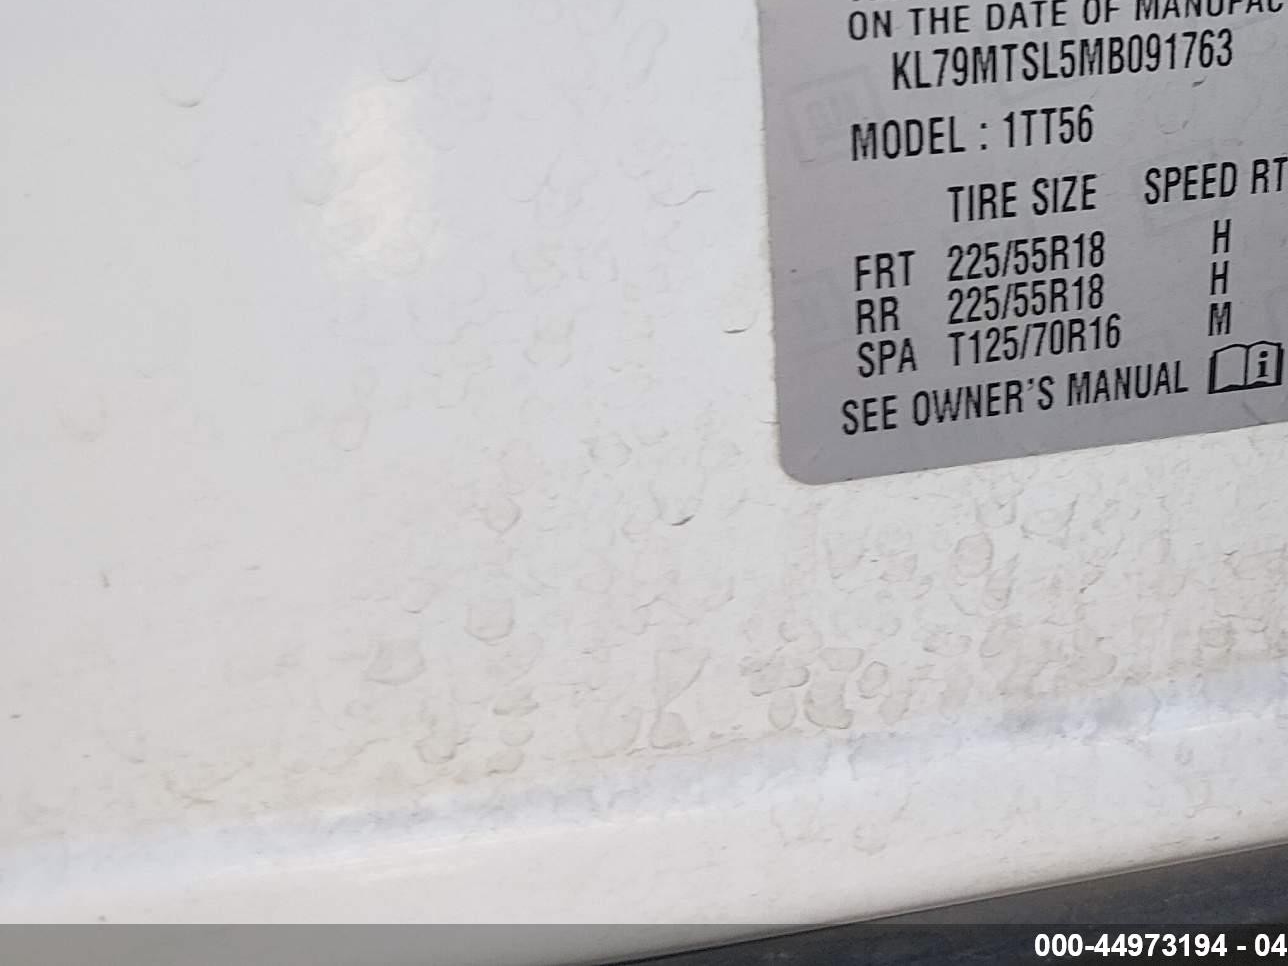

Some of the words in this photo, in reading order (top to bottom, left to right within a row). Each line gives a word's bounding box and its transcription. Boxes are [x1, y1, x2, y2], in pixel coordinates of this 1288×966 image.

[849, 11, 891, 40] ON
[909, 6, 969, 35] THE
[987, 0, 1066, 30] DATE
[893, 28, 1232, 90] KL79MTSL5MB091763
[852, 116, 965, 161] MODEL
[1004, 105, 1093, 147] 1TT56
[948, 182, 1016, 222] TIRE
[1033, 174, 1096, 215] SIZE
[1145, 162, 1237, 204] SPEED
[948, 231, 1104, 281] 225/55R18
[1213, 219, 1230, 254] H
[856, 251, 914, 291] FRT
[1211, 261, 1228, 295] H
[857, 297, 899, 334] RR
[949, 274, 1103, 324] 225/55R18
[1208, 302, 1231, 336] M
[859, 338, 916, 378] SPA
[949, 314, 1120, 366] T125/70R16
[843, 395, 896, 435] SEE
[914, 376, 1054, 426] OWNER'S
[1068, 361, 1188, 406] MANUAL
